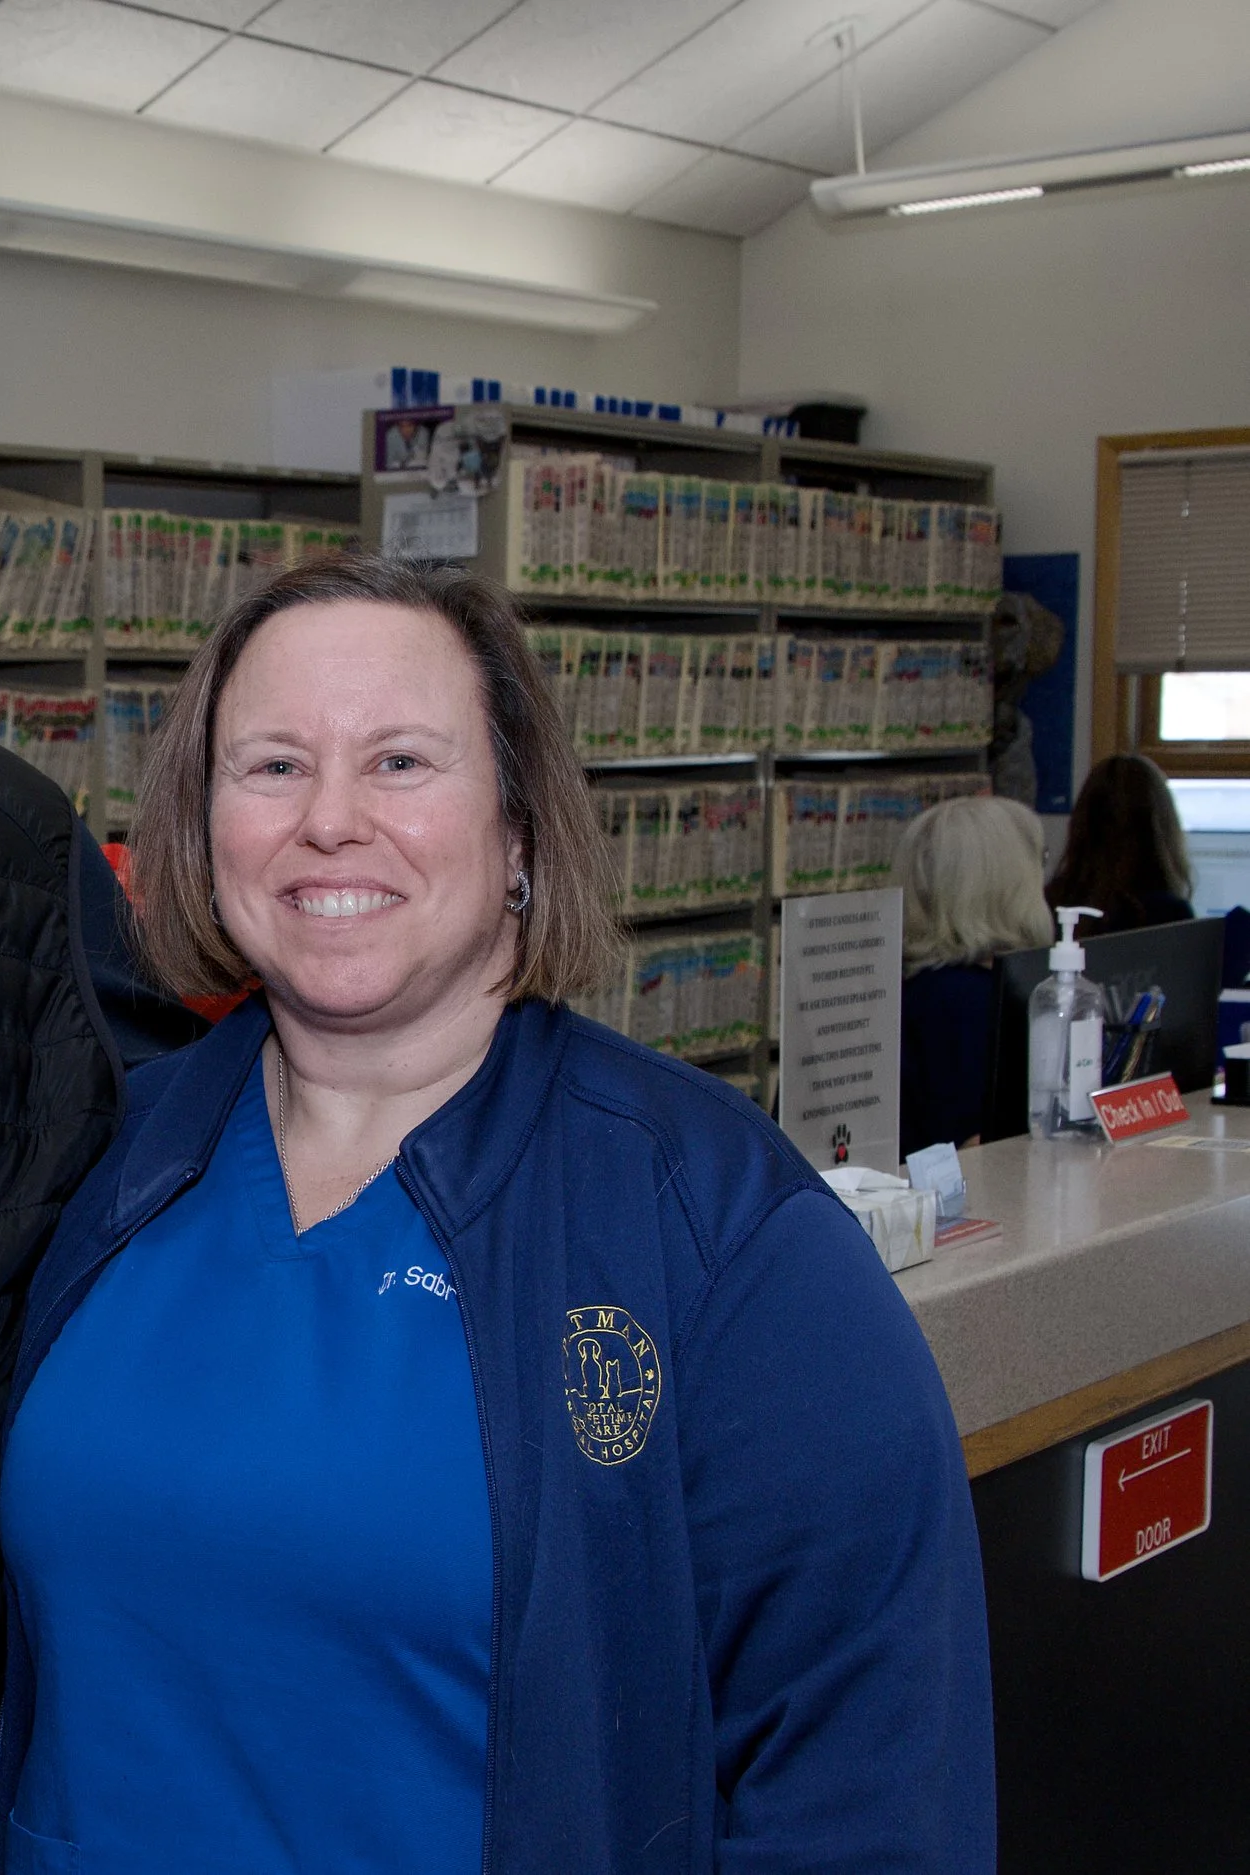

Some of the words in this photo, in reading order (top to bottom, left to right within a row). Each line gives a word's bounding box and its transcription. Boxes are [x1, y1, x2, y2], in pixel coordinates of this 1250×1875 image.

[1101, 1097, 1143, 1129] Check
[1137, 1096, 1156, 1119] In
[1150, 1092, 1161, 1117] /
[1156, 1089, 1185, 1113] Out
[563, 1311, 650, 1358] TMAN
[583, 1401, 624, 1414] OTAL
[586, 1412, 633, 1425] ETIME
[1142, 1425, 1173, 1460] EXIT
[1135, 1517, 1171, 1555] DOOR
